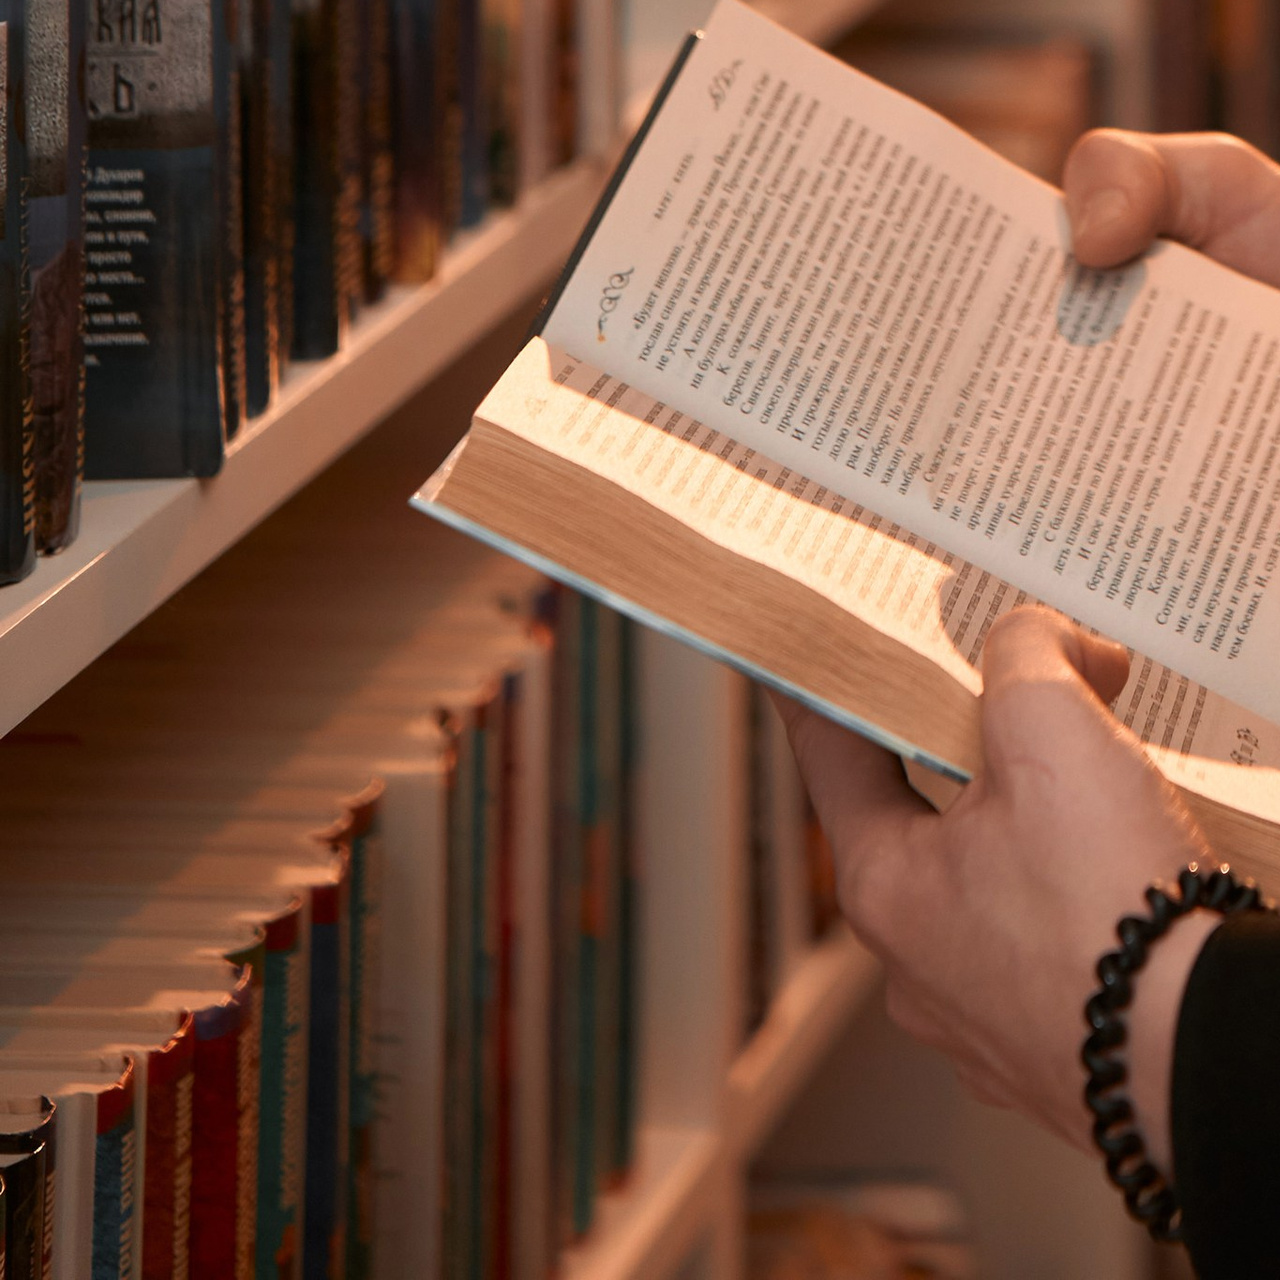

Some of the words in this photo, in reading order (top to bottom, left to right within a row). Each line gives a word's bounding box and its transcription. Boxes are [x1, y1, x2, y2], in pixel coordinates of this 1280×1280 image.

[632, 290, 658, 329] «Будет
[653, 245, 684, 289] неплохо,
[638, 321, 664, 361] тослав
[660, 276, 688, 320] сначала
[682, 230, 711, 276] пограбит
[655, 354, 669, 371] не
[664, 308, 695, 355] устоять,
[689, 296, 699, 305] и
[694, 251, 722, 296] хорошая
[716, 218, 739, 251] трепка
[683, 348, 695, 358] А
[690, 313, 713, 345] когда
[708, 276, 731, 312] воины
[725, 242, 749, 275] хакана
[690, 372, 703, 388] на
[697, 322, 730, 371] булгарах
[725, 282, 750, 322] добыча
[744, 257, 762, 281] тоже
[716, 363, 730, 375] К
[728, 296, 766, 359] сожалению,
[760, 241, 791, 290] флотилия
[722, 360, 755, 406] берегов.
[749, 315, 779, 352] Значит,
[773, 282, 793, 309] через
[739, 348, 781, 414] Святослава
[777, 294, 807, 347] достигнет
[759, 384, 784, 424] своего
[780, 345, 804, 385] дворца
[799, 315, 818, 344] хакан
[813, 281, 835, 317] увидит
[776, 366, 818, 433] произойдет,
[812, 342, 827, 361] тем
[822, 309, 845, 341] лучше,
[791, 428, 805, 441] И
[801, 359, 840, 426] прожорлива
[834, 338, 850, 358] под
[845, 312, 862, 338] стать
[810, 385, 848, 451] готысячное
[844, 332, 874, 385] ополчение.
[958, 371, 980, 401] Итиль
[828, 427, 849, 461] долю
[844, 346, 891, 427] продовольствия,
[845, 444, 863, 470] рам.
[856, 380, 893, 440] Подданные
[888, 341, 911, 381] должны
[862, 424, 893, 477] наоборот.
[887, 404, 902, 421] Но
[898, 378, 915, 405] долю
[880, 446, 906, 485] хакану
[899, 384, 934, 445] приходилось
[932, 496, 944, 511] мя
[939, 471, 958, 494] года,
[952, 452, 965, 466] так
[959, 430, 973, 447] что
[969, 399, 990, 429] никто,
[984, 371, 1000, 395] даже
[952, 401, 966, 418] что
[995, 419, 1021, 464] арабским
[898, 452, 924, 495] амбары.
[922, 443, 947, 482] Счастье
[949, 505, 961, 521] не
[956, 467, 979, 503] помрет
[990, 409, 1003, 420] И
[967, 473, 997, 530] аргамакам
[984, 502, 1006, 539] ливые
[999, 451, 1028, 499] хузарские
[1022, 408, 1046, 451] лошадки
[991, 464, 1001, 472] и
[1007, 464, 1043, 525] Повелитель
[1037, 436, 1056, 462] хузар
[1049, 423, 1061, 435] не
[1019, 510, 1043, 556] евского
[1038, 478, 1057, 509] князя
[1051, 428, 1079, 477] появилась
[1048, 486, 1076, 530] балкона
[1070, 452, 1088, 485] своего
[1120, 501, 1132, 514] на
[1043, 530, 1055, 542] С
[1053, 548, 1070, 575] деть
[1064, 489, 1095, 545] плывущие
[1089, 474, 1101, 488] по
[1077, 546, 1091, 559] И
[1086, 519, 1103, 545] свое
[1098, 464, 1126, 517] несметное
[1104, 524, 1122, 553] реки
[1105, 551, 1131, 599] правого
[1124, 513, 1148, 549] берега
[1143, 476, 1165, 511] остров,
[1116, 514, 1126, 523] и
[1146, 538, 1179, 594] Кораблей
[1172, 505, 1192, 533] было
[1229, 544, 1239, 552] в
[1233, 489, 1260, 544] сравнении
[1250, 503, 1276, 549] торговые
[1086, 551, 1111, 591] берегу
[1123, 566, 1148, 609] дворец
[1141, 527, 1163, 564] хакана.
[1155, 584, 1183, 625] Сотни,
[1176, 559, 1194, 580] нет,
[1186, 511, 1209, 554] тысячи!
[1175, 614, 1191, 632] ми,
[1186, 525, 1225, 609] скандинавские
[1203, 552, 1235, 617] неуклюжие
[1227, 636, 1243, 659] чем
[1236, 592, 1262, 635] боевых.
[1254, 575, 1270, 587] И,
[1264, 547, 1279, 572] судя
[1229, 595, 1239, 604] и
[1233, 552, 1256, 592] прочие
[1193, 621, 1210, 643] сах,
[1210, 607, 1234, 652] насады
